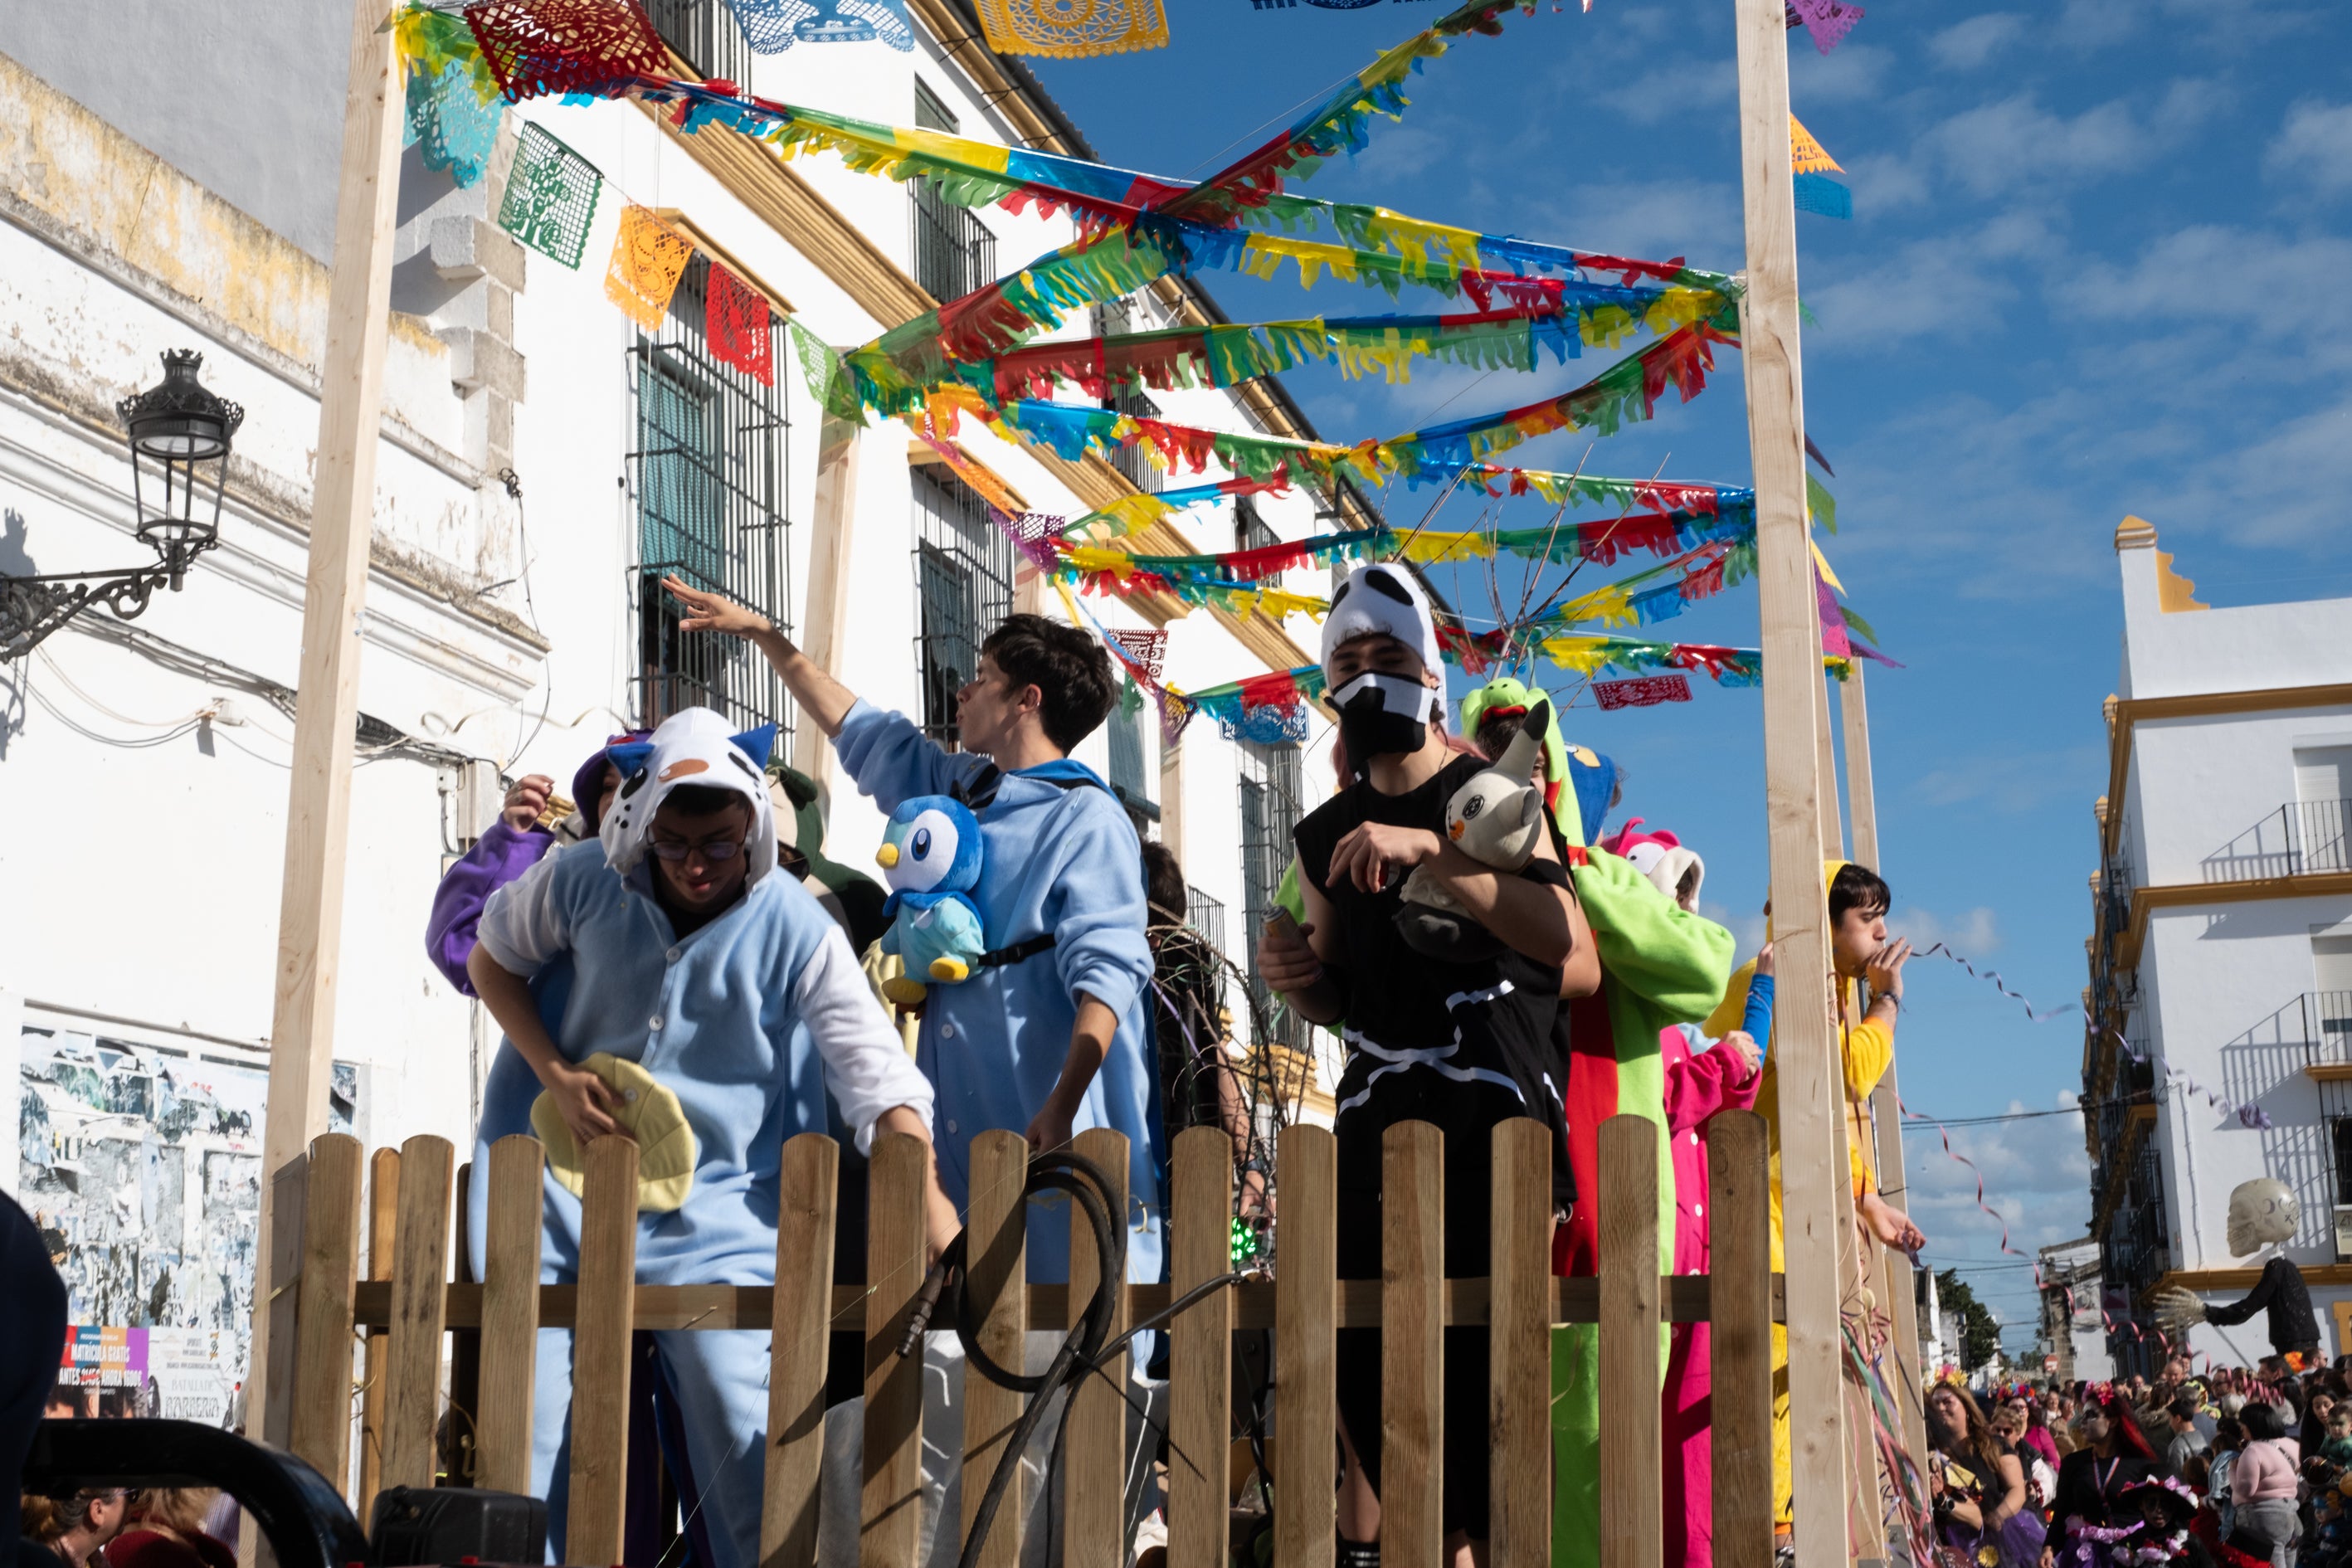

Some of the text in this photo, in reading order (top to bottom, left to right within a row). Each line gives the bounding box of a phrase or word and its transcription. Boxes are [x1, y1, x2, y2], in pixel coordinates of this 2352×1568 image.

[71, 1341, 130, 1363] MATRÍCULA GRATIS
[58, 1367, 80, 1385] ANTES
[100, 1370, 122, 1387] AHORA
